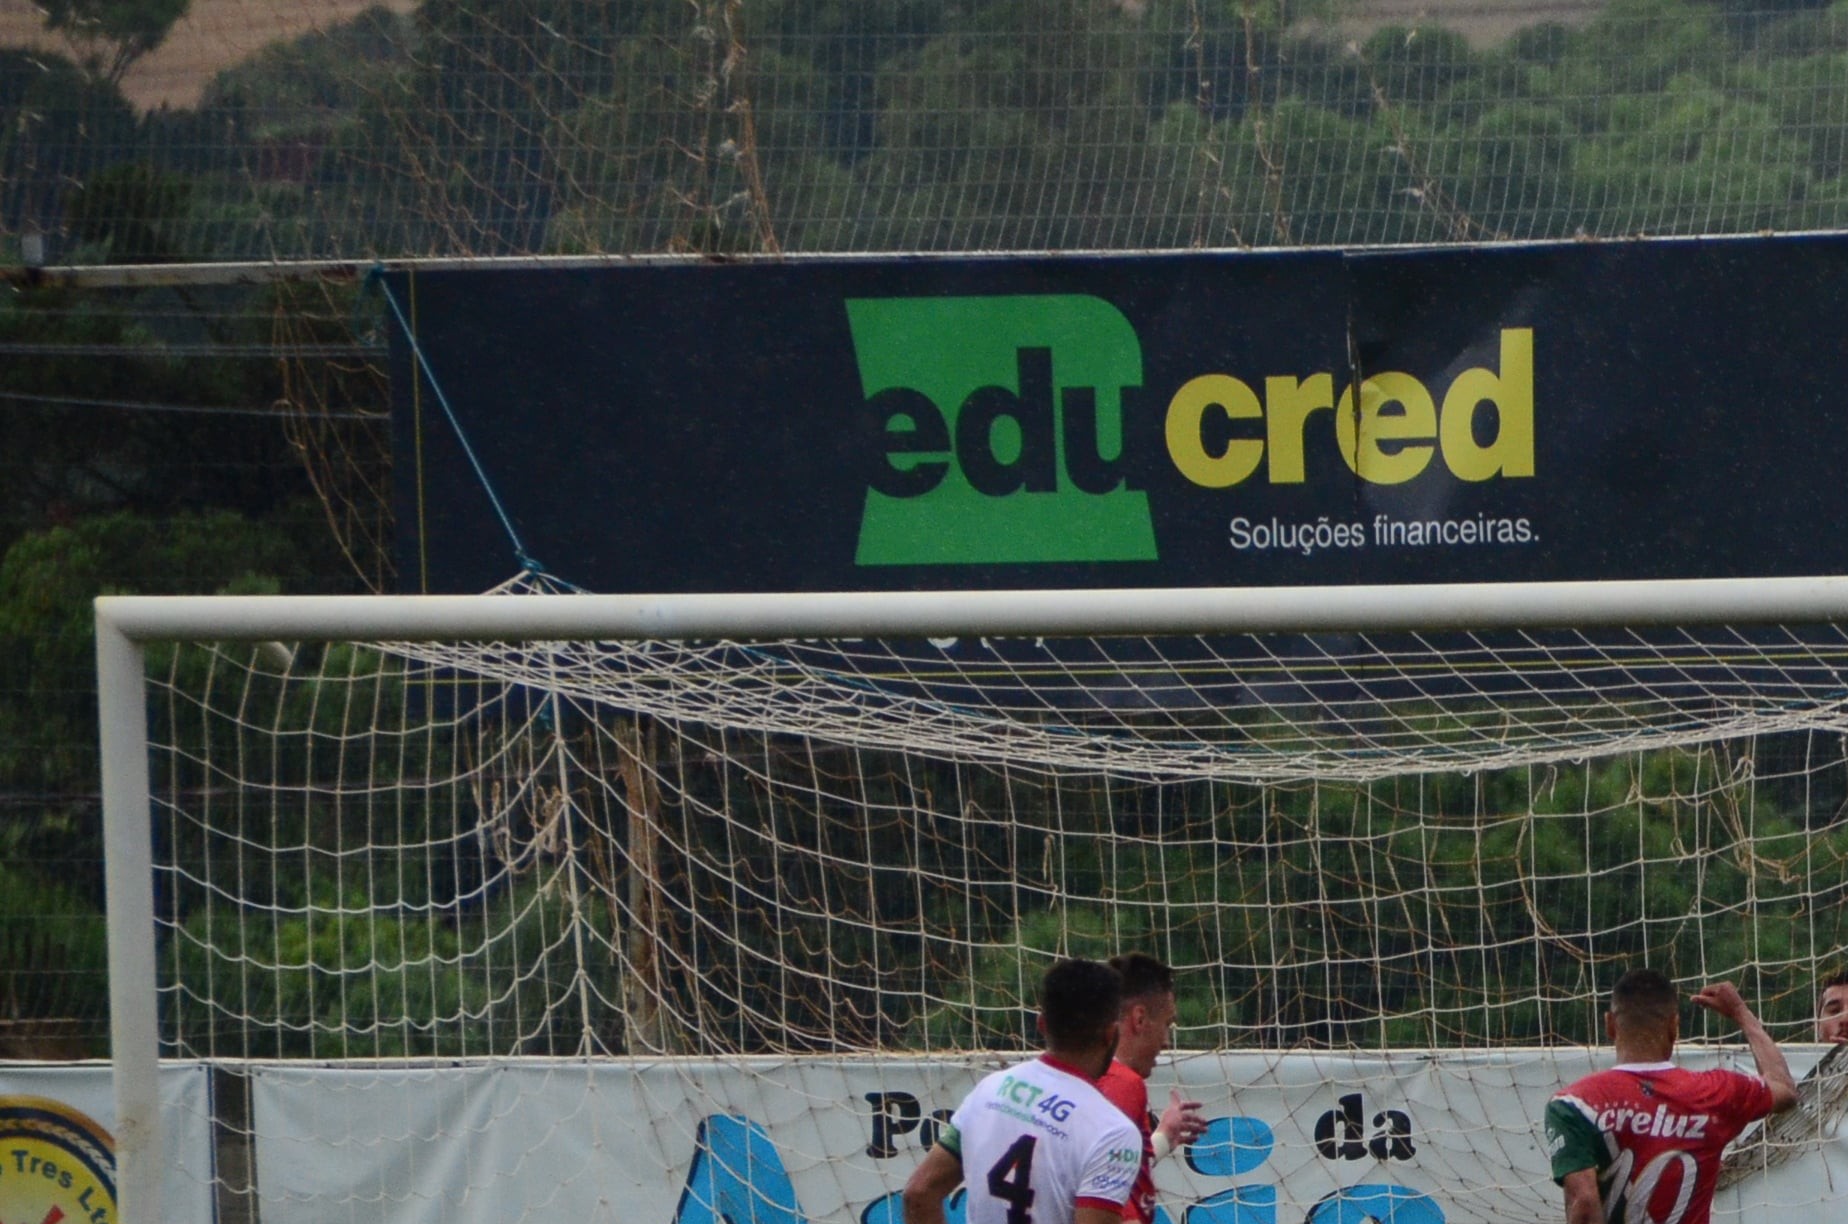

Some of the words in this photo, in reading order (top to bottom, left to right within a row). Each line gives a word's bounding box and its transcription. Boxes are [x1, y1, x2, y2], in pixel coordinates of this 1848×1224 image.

[1230, 516, 1365, 555] Soluções
[1373, 512, 1540, 546] financeiras.
[1037, 1093, 1077, 1123] 4G
[1314, 1093, 1417, 1161] da
[1599, 1103, 1710, 1140] creluz
[12, 1149, 73, 1189] Tres
